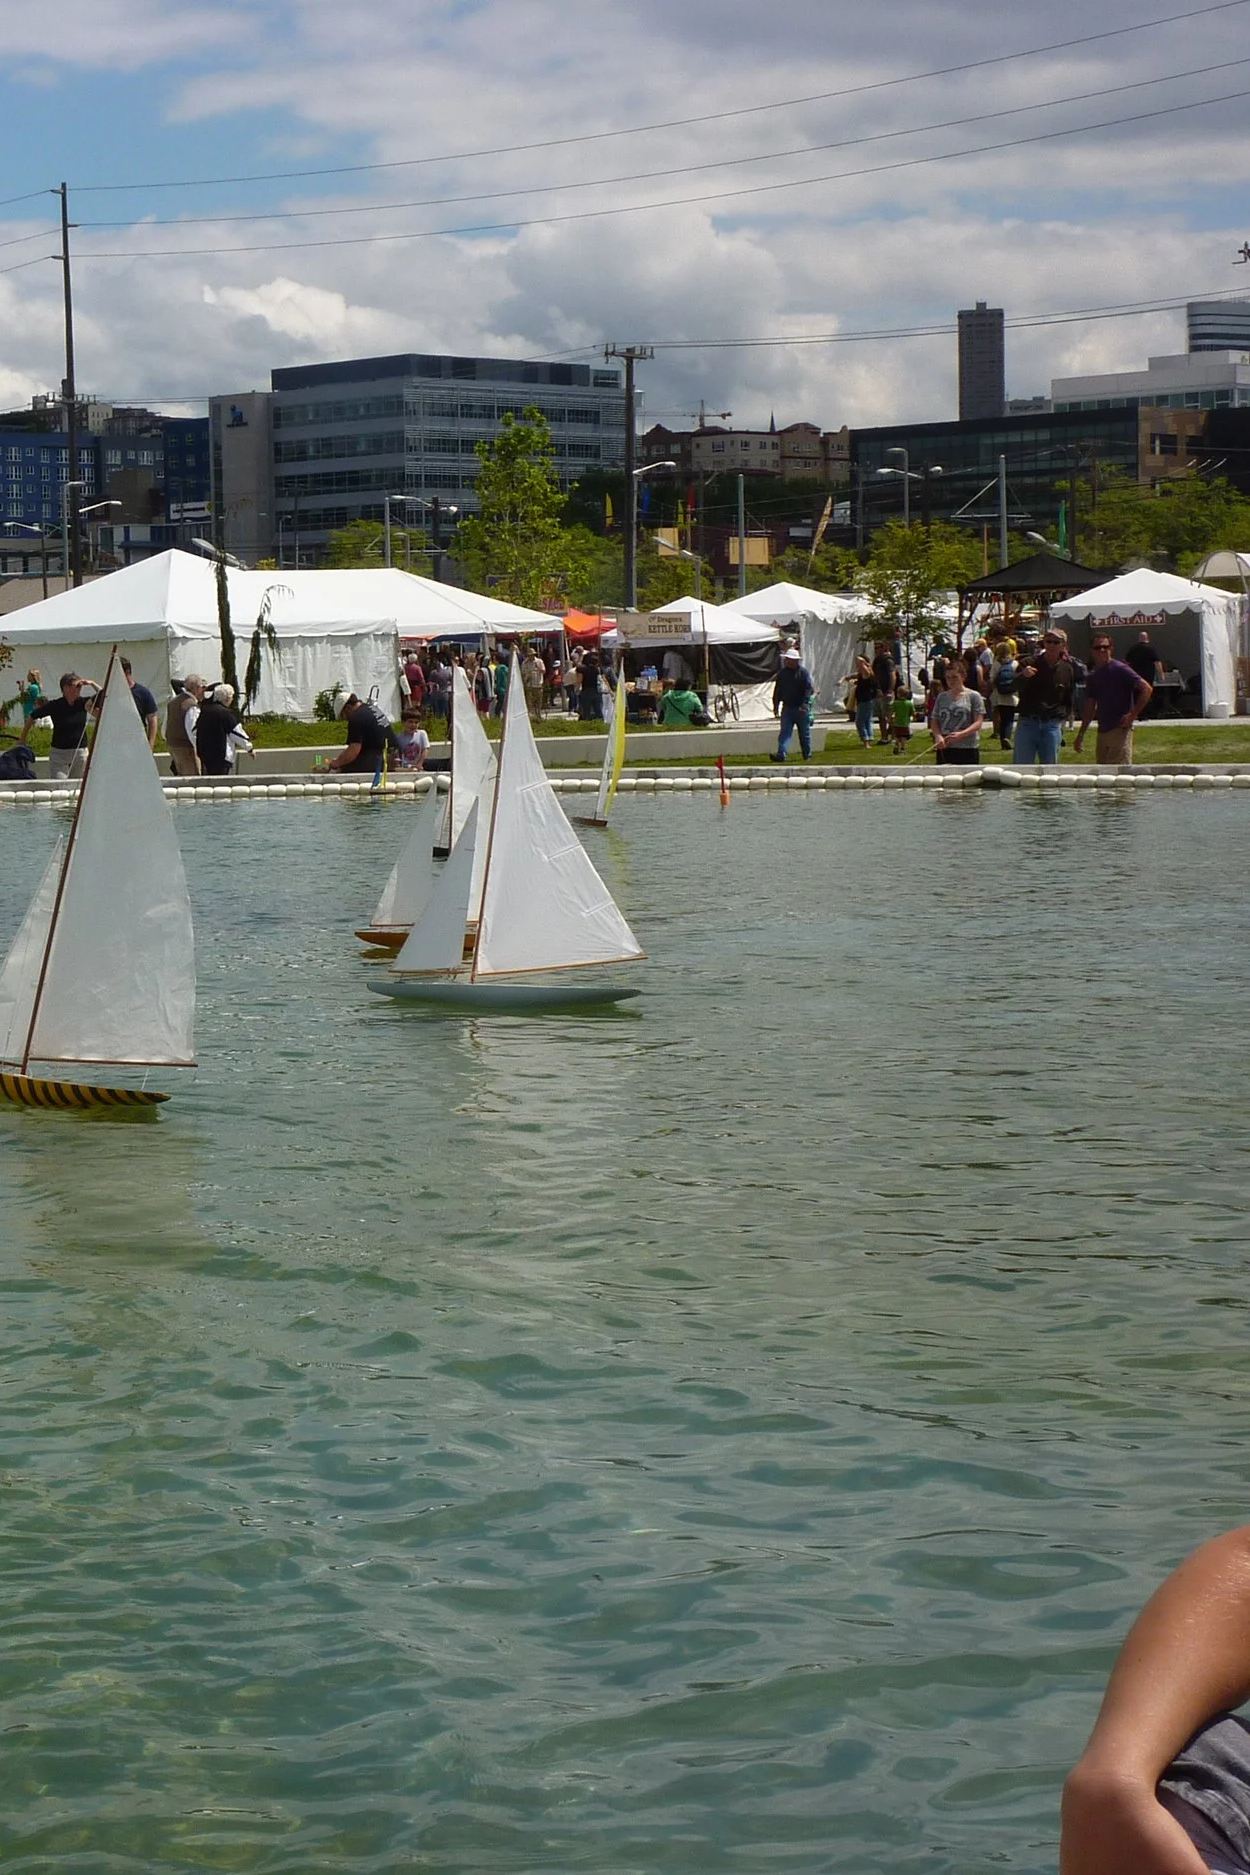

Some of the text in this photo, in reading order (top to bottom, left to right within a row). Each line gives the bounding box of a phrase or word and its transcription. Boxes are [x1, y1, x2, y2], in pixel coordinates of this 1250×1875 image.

[1104, 614, 1153, 625] FIRST AID
[648, 624, 673, 633] KETTLE
[939, 706, 969, 732] 22
